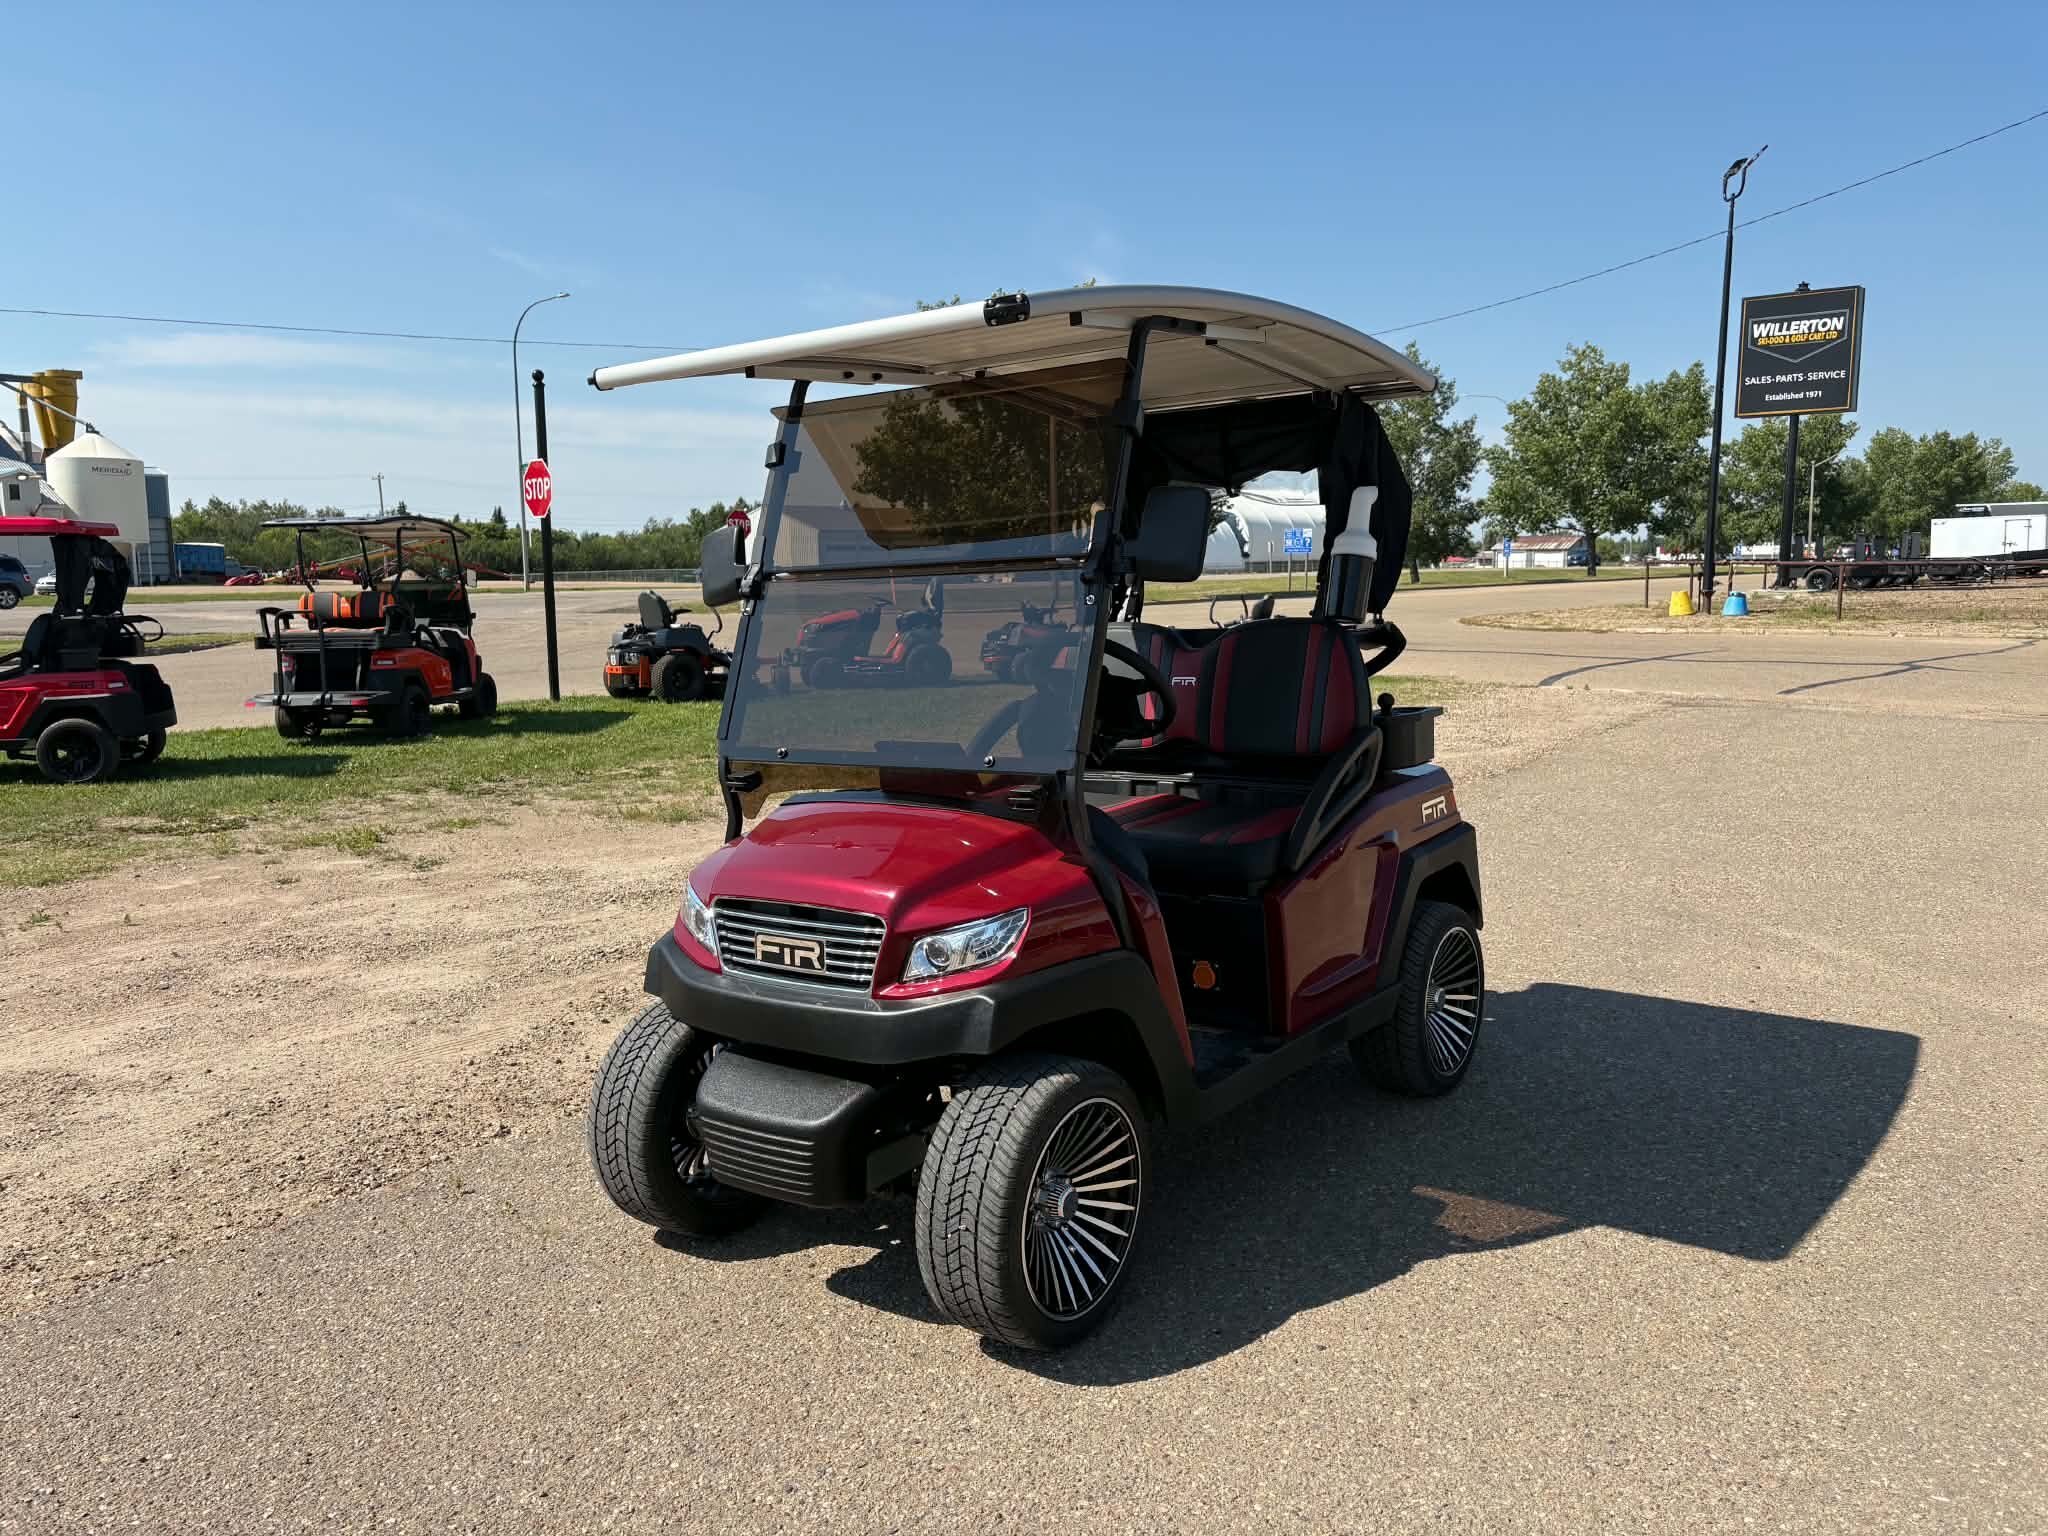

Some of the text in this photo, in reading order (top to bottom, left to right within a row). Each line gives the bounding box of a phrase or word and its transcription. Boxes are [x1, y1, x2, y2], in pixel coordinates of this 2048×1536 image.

[1753, 316, 1845, 338] WILLERTON
[1758, 335, 1785, 346] SKI-DOO
[1791, 333, 1808, 342] GOLF
[1809, 332, 1825, 341] CART
[1765, 390, 1822, 401] Established 1971
[525, 477, 550, 500] STOP
